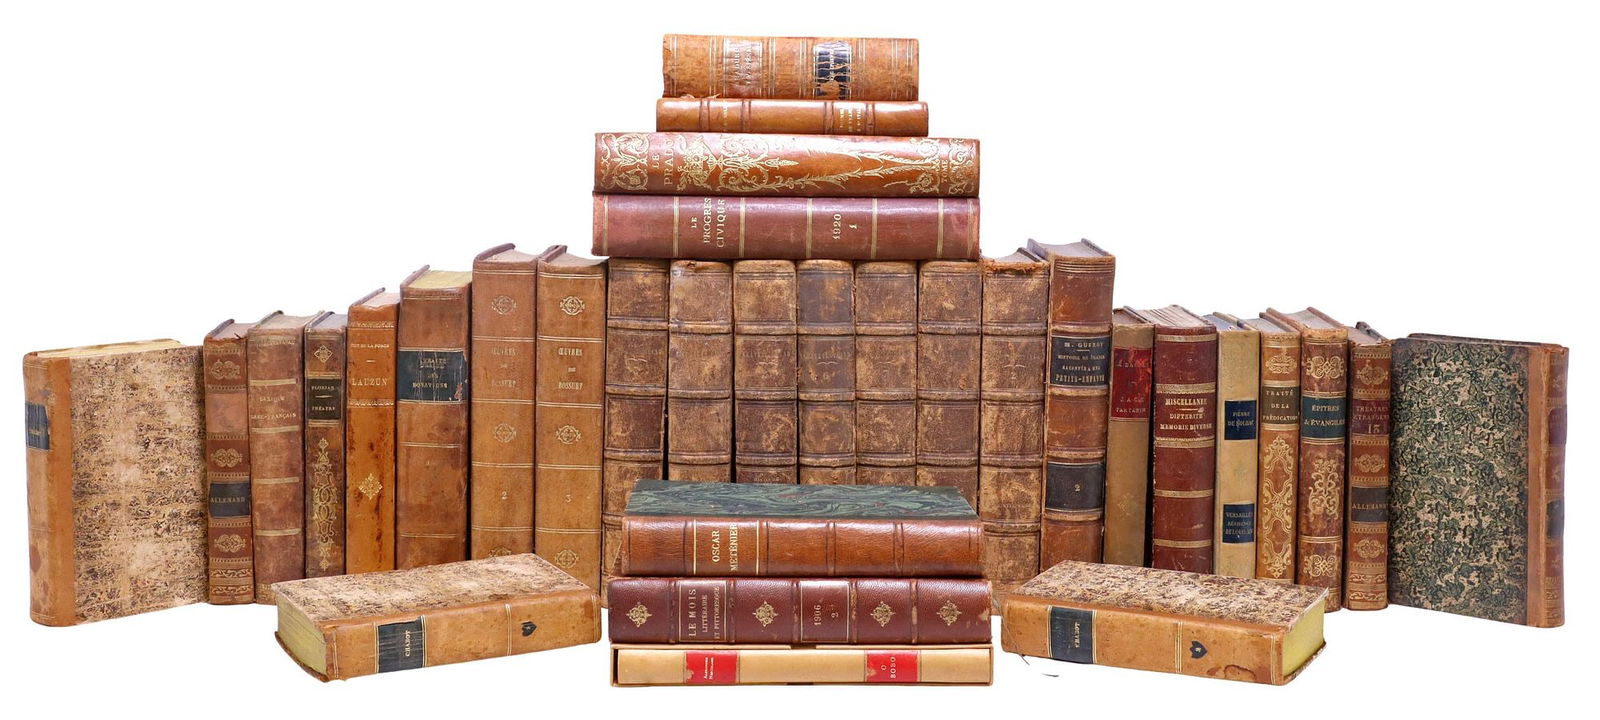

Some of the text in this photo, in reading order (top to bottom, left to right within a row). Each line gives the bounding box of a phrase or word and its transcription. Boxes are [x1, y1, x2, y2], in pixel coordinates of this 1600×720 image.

[652, 153, 660, 169] LE
[664, 140, 674, 186] PRADO
[691, 217, 698, 229] LE
[832, 213, 842, 240] 1920
[351, 377, 388, 386] LAUZUN
[501, 489, 508, 500] 2
[1074, 483, 1081, 492] 2
[565, 494, 573, 503] 3
[711, 529, 720, 563] OSCAR
[688, 588, 697, 637] LE MOIS
[813, 604, 822, 626] 1906
[713, 631, 720, 639] ET
